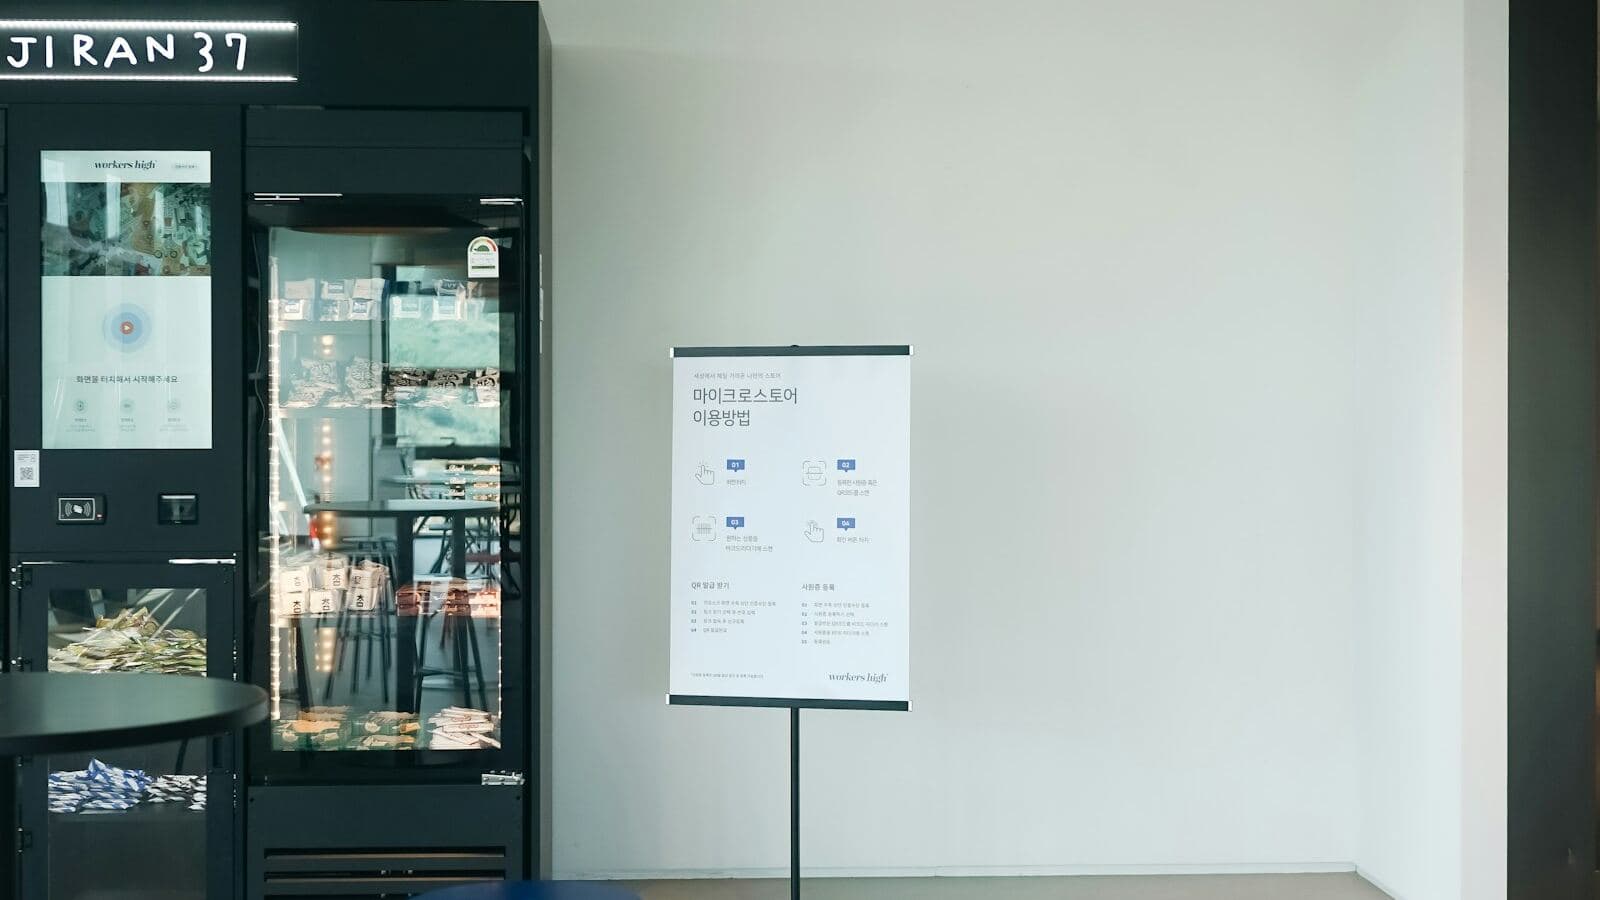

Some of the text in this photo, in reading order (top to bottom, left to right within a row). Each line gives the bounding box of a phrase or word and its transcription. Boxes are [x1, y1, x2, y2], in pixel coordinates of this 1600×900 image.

[194, 31, 248, 73] 37
[94, 159, 156, 170] workers high
[76, 375, 98, 384] 화면을
[100, 375, 130, 384] 터치해서
[693, 387, 797, 404] 마이크로스토어
[693, 409, 750, 427] 이용방법
[828, 672, 888, 683] workers high
